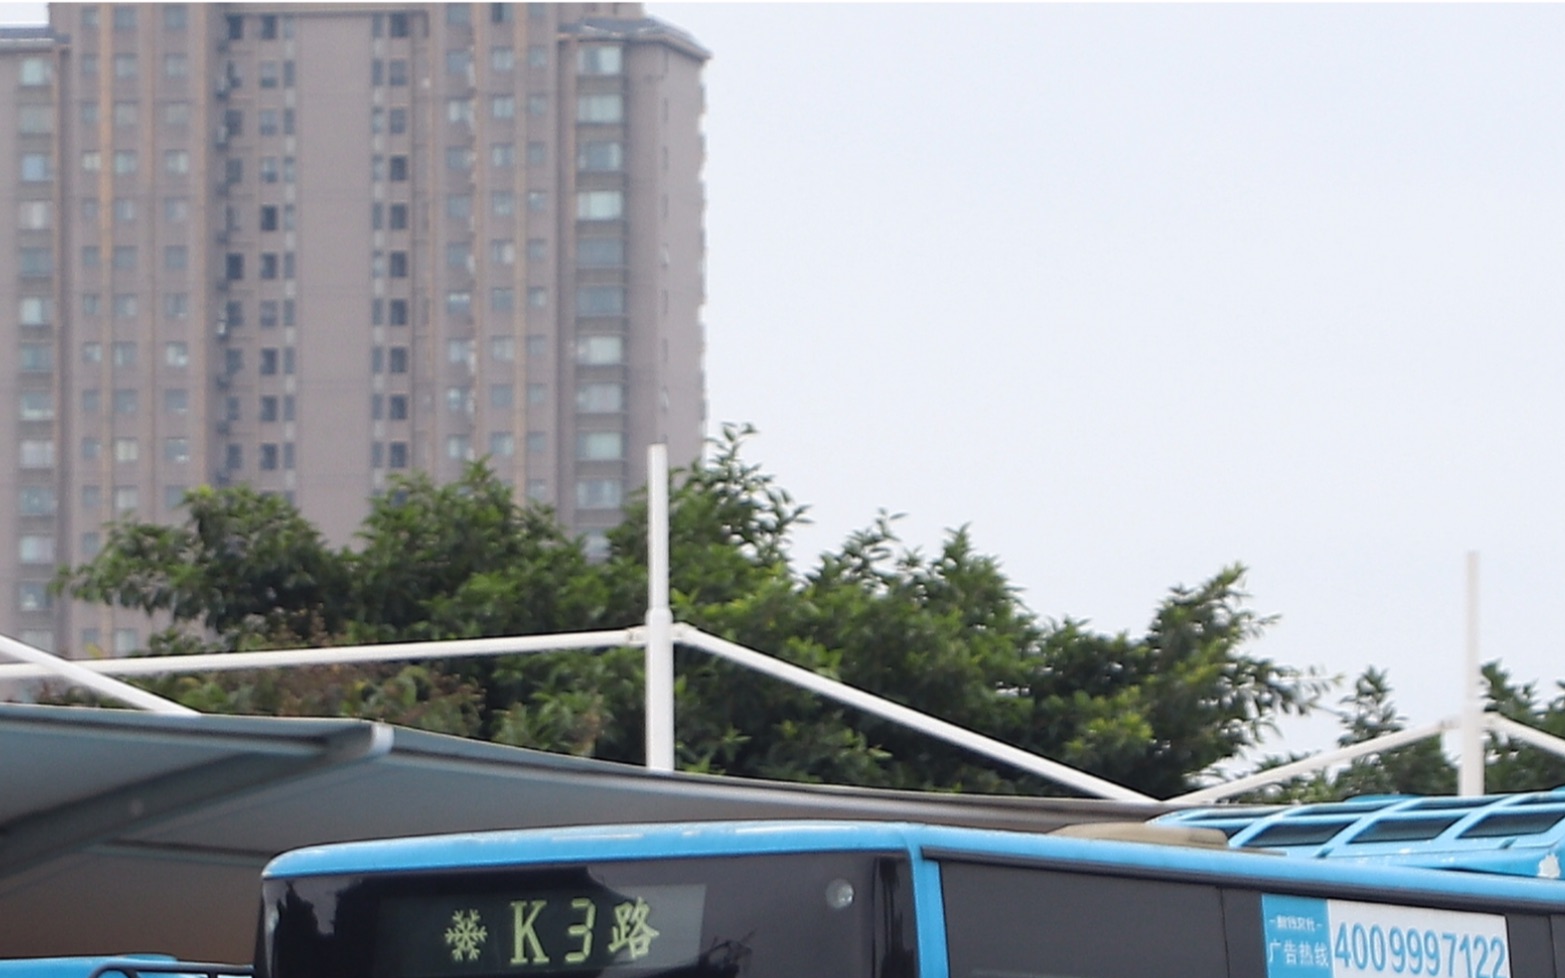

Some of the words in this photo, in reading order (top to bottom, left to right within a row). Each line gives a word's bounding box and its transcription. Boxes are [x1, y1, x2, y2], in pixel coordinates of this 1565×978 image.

[510, 897, 660, 964] K3路
[1268, 939, 1329, 968] 广告热线
